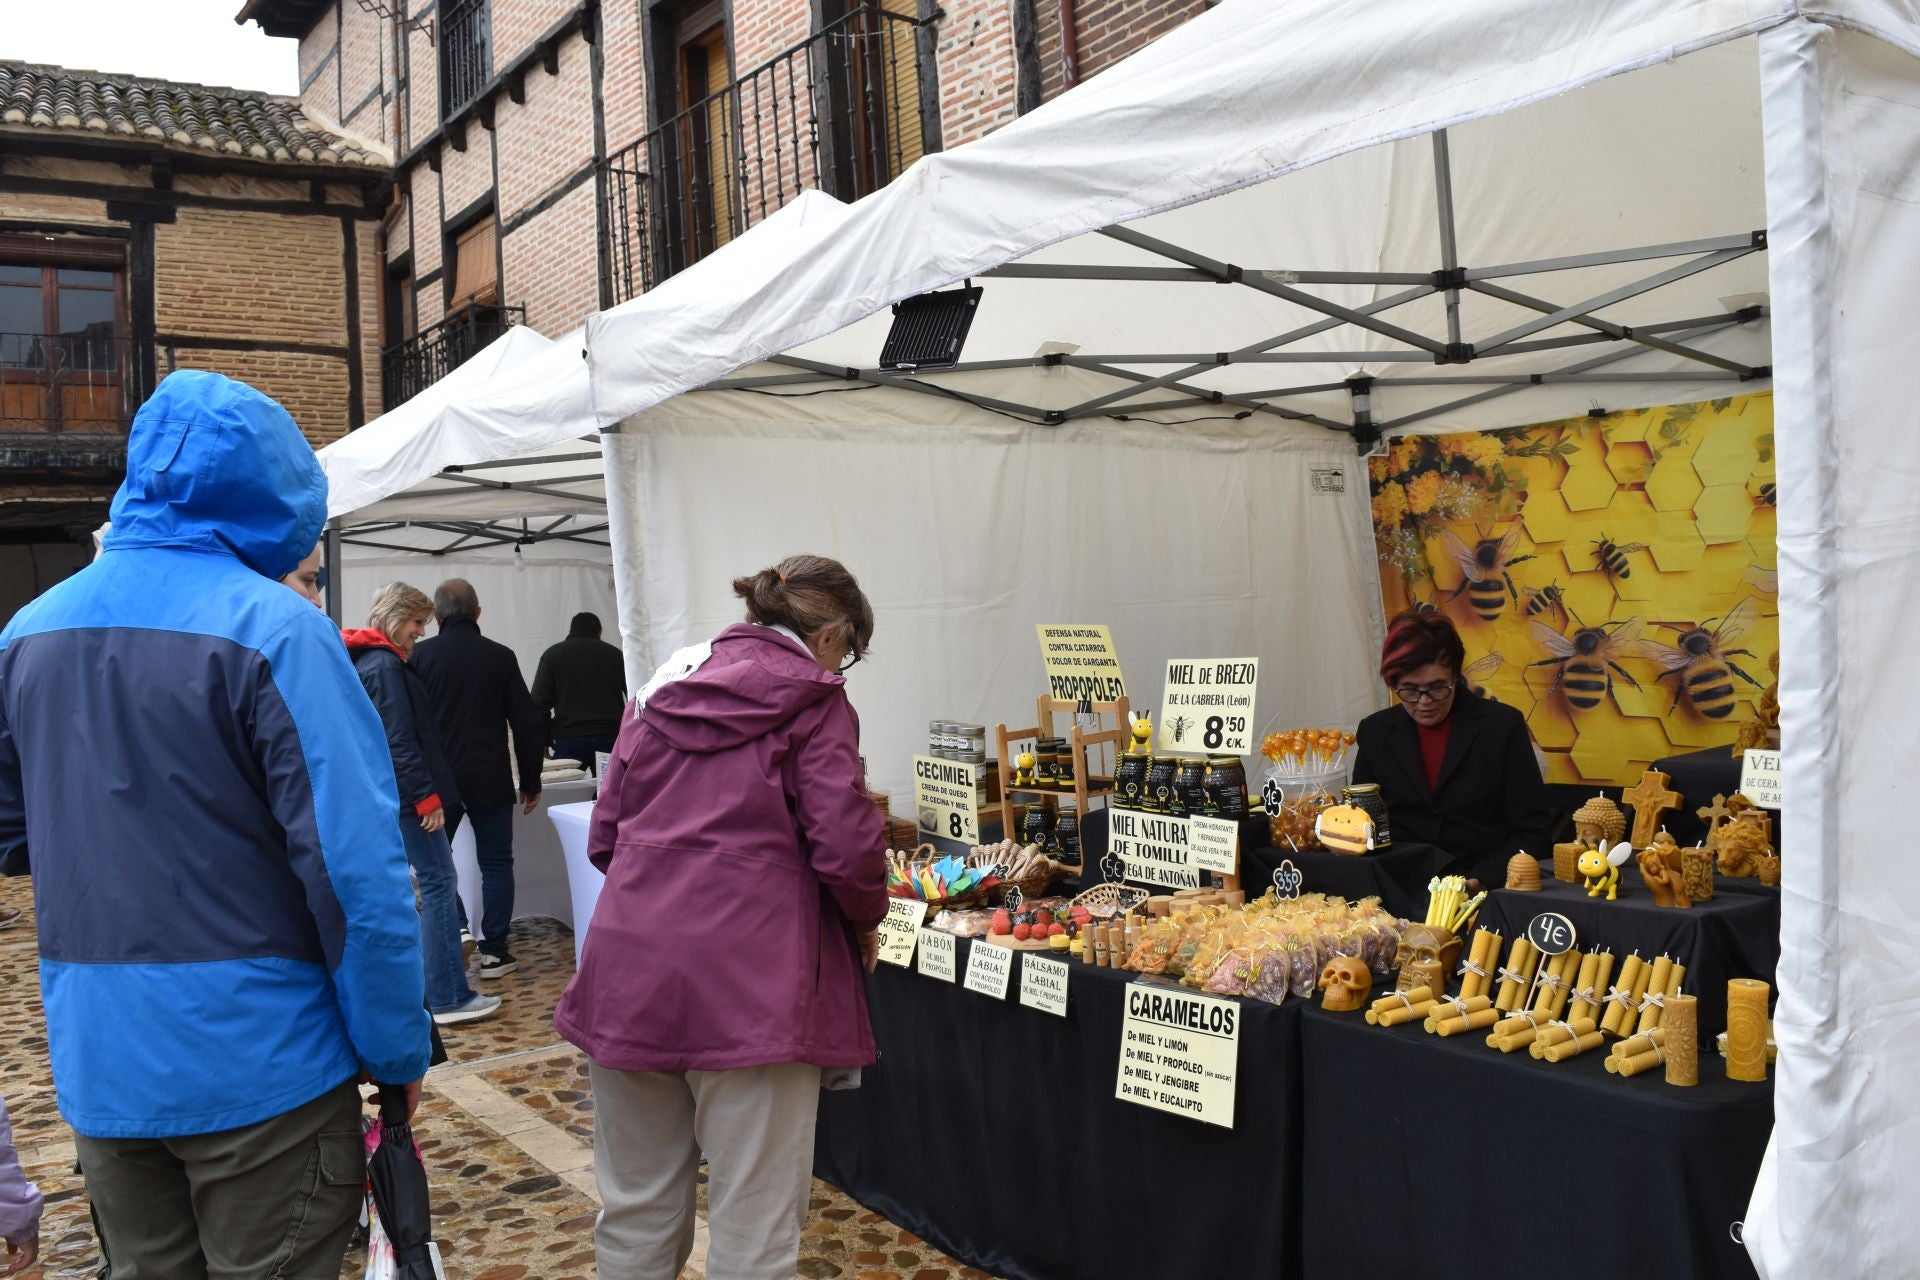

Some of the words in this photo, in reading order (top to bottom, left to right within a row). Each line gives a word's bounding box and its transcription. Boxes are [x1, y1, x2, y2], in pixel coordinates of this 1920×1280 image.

[1045, 629, 1072, 638] DEFENSA
[1072, 630, 1102, 638] NATURAL
[1048, 644, 1074, 652] CONTRA
[1074, 644, 1106, 652] CATARROS
[1073, 658, 1082, 666] DE
[1083, 658, 1118, 667] GARGANTA
[1168, 665, 1195, 684] MIEL
[1198, 668, 1212, 684] DE
[1216, 664, 1255, 684] BREZO
[1168, 694, 1178, 704] DE
[1180, 694, 1190, 705] LA
[1192, 694, 1224, 706] CABRERA
[1226, 694, 1250, 708] (León)
[916, 760, 973, 788] CECIMIEL
[922, 783, 940, 793] CREMA
[940, 786, 948, 794] DE
[948, 786, 968, 799] QUESO
[1746, 778, 1756, 786] DE
[1758, 778, 1778, 788] CERA
[922, 794, 928, 802] DE
[930, 796, 950, 806] CECINA
[950, 800, 954, 808] Y
[956, 802, 969, 811] MIEL
[1266, 790, 1277, 806] 1€
[1760, 792, 1770, 802] DE
[950, 812, 962, 838] 8
[1112, 814, 1138, 838] MIEL
[1194, 820, 1208, 828] CREMA
[1208, 824, 1234, 834] HIDRATANTE
[1200, 834, 1228, 844] REPARADORA
[1114, 839, 1130, 856] DE
[1208, 847, 1220, 855] VERA
[1223, 850, 1232, 858] MIEL
[1106, 859, 1121, 878] 5€
[1126, 862, 1142, 878] EGA
[1146, 866, 1156, 880] DE
[1158, 868, 1198, 888] ANTOÑÁN
[890, 902, 914, 916] BRES
[881, 918, 914, 934] RPRESA
[1540, 916, 1566, 946] 4€
[920, 934, 952, 952] JABÓN
[926, 952, 933, 960] DE
[934, 954, 946, 964] MIEL
[974, 944, 1007, 960] BRILLO
[920, 960, 924, 968] Y
[926, 962, 952, 976] PROPÓLEO
[972, 958, 1004, 975] LABIAL
[1024, 958, 1066, 977] BÁLSAMO
[970, 970, 980, 978] CON
[981, 973, 1003, 986] ACEITES
[1029, 974, 1060, 991] LABIAL
[970, 979, 975, 987] Y
[974, 980, 1001, 994] PROPÓLEO
[1023, 986, 1028, 994] DE
[1029, 988, 1038, 996] MIEL
[1130, 990, 1234, 1035] CARAMELOS
[1128, 1030, 1136, 1040] De
[1138, 1032, 1156, 1046] MIEL
[1158, 1036, 1162, 1046] Y
[1164, 1038, 1188, 1052] LIMÓN
[1126, 1048, 1136, 1058] De
[1137, 1050, 1154, 1064] MIEL
[1156, 1054, 1161, 1064] Y
[1163, 1056, 1202, 1075] PROPÓLEO
[1124, 1066, 1134, 1076] De
[1136, 1068, 1152, 1082] MIEL
[1155, 1072, 1160, 1083] Y
[1162, 1074, 1200, 1093] JENGIBRE
[1122, 1083, 1132, 1094] De
[1134, 1086, 1150, 1100] MIEL
[1154, 1090, 1158, 1101] Y
[1160, 1092, 1202, 1112] EUCALIPTO
